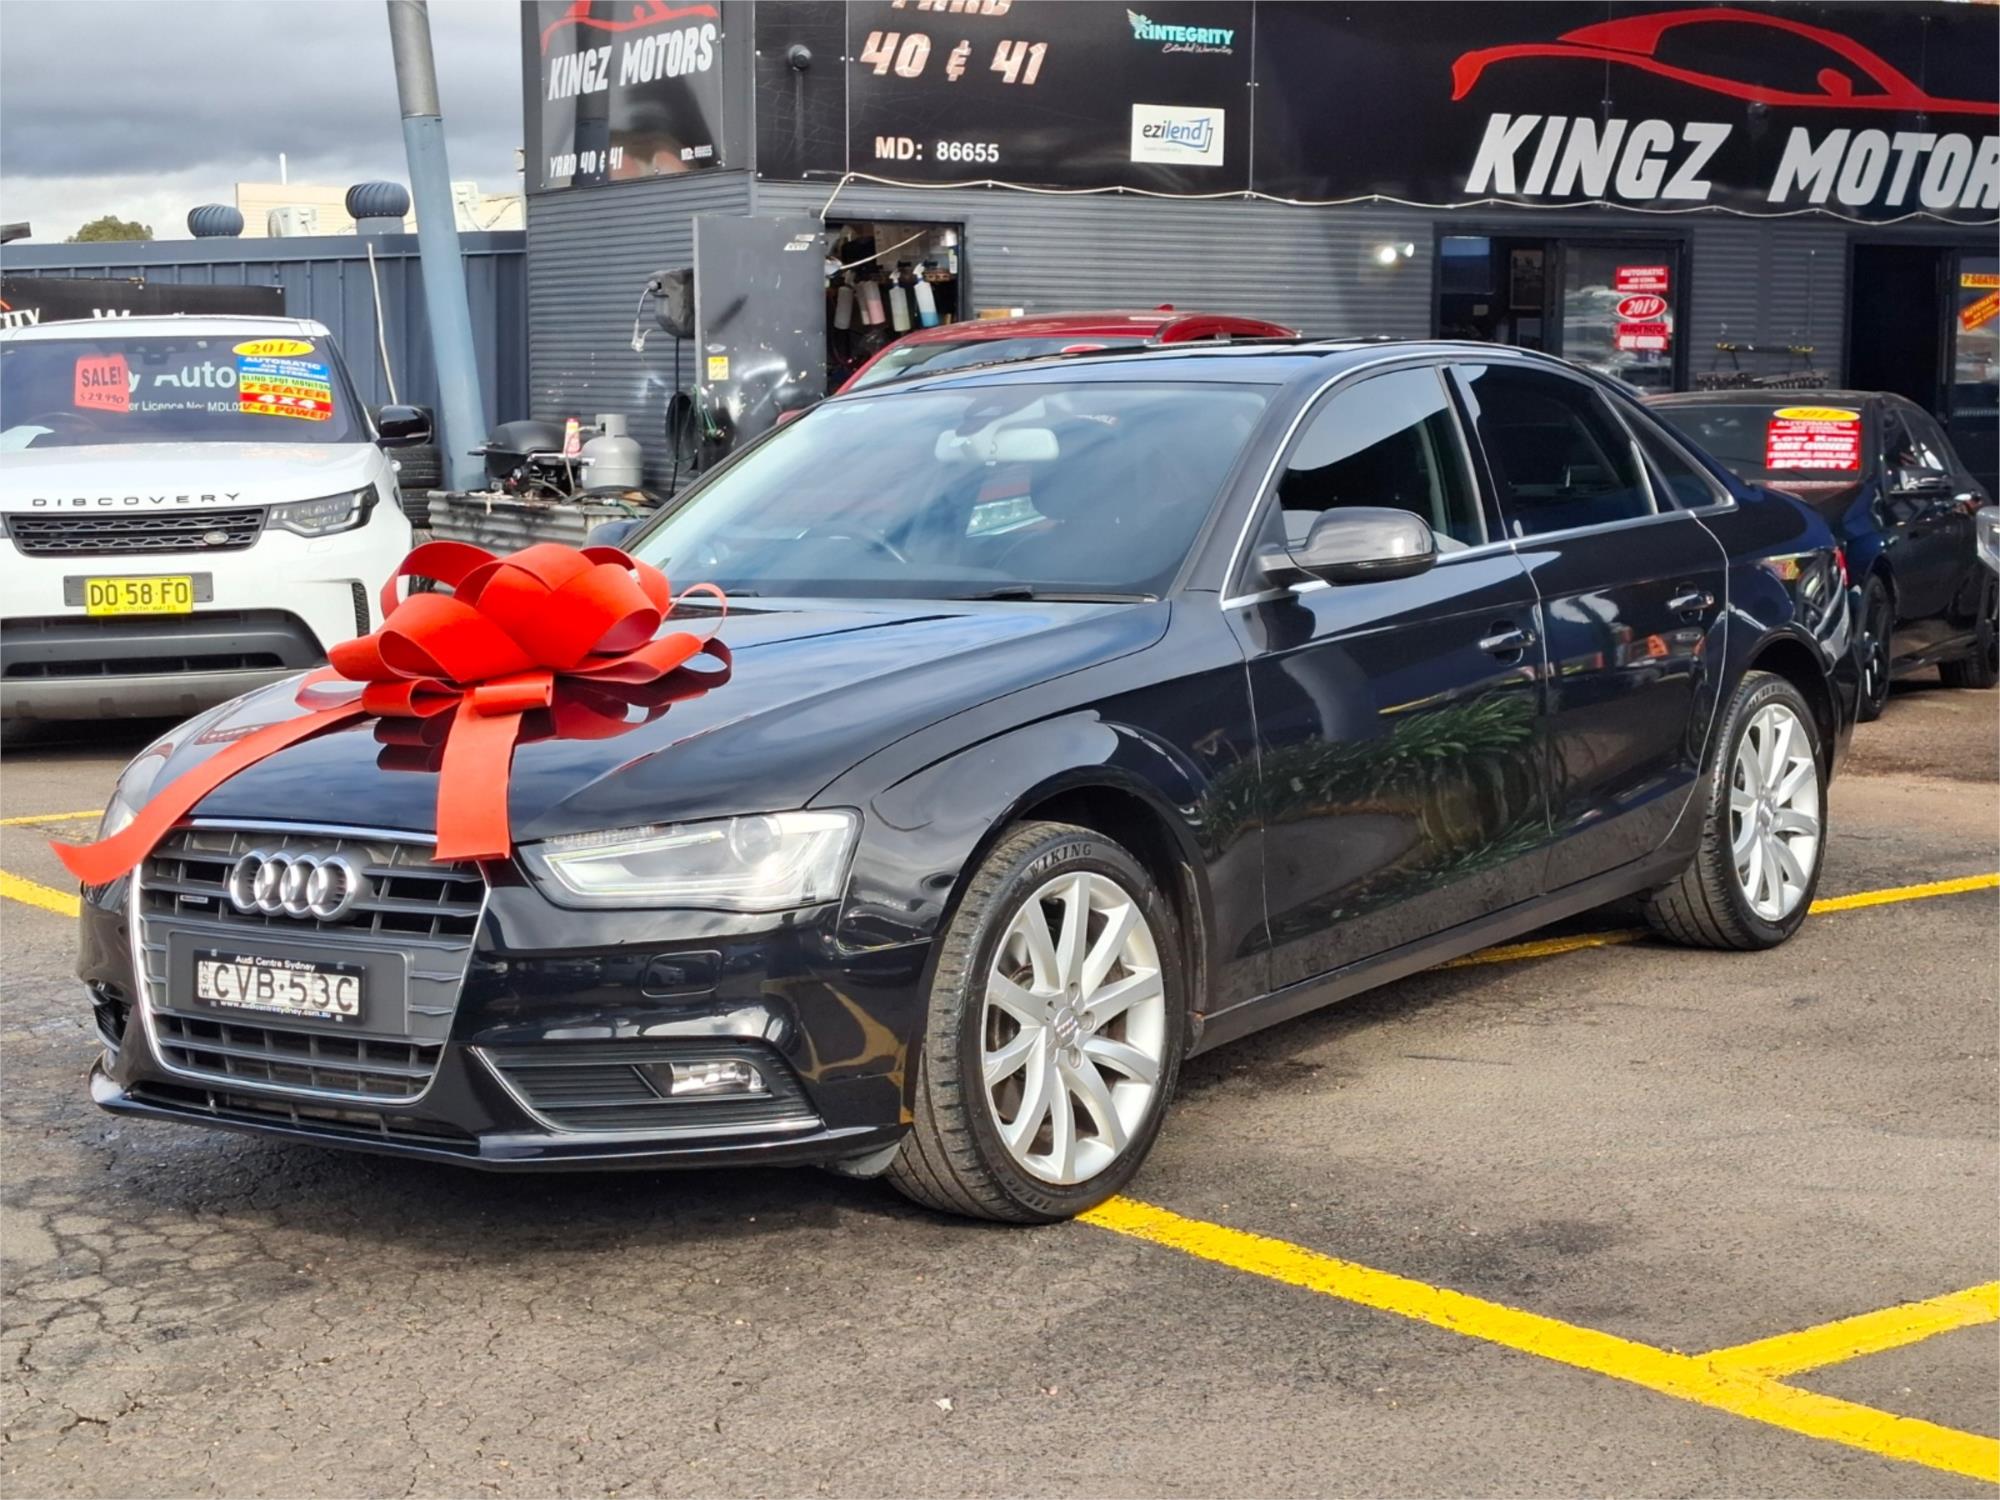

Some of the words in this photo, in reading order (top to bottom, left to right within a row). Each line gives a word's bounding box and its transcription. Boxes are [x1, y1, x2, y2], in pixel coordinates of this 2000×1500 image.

[1149, 25, 1234, 45] INTEGRITY
[548, 45, 612, 100] KINGZ
[619, 23, 716, 87] MOTORS
[860, 31, 932, 78] 40
[990, 40, 1048, 84] 41
[1142, 118, 1205, 140] ezilend
[875, 136, 923, 160] MD:
[936, 141, 1000, 163] 86655
[1464, 113, 1733, 199] KINGZ
[550, 153, 576, 178] YARD
[580, 151, 596, 174] 40
[609, 146, 624, 170] 41
[1625, 299, 1659, 315] 2019
[250, 342, 298, 355] 2017
[245, 357, 320, 369] AUTOMATIC
[82, 366, 122, 388] SALE!
[241, 374, 266, 382] BLIND
[269, 376, 289, 384] SPOT
[243, 382, 256, 391] 7
[259, 384, 327, 399] SEATER
[275, 405, 329, 419] POWER
[1773, 460, 1853, 468] SPORTY
[32, 492, 240, 506] DISCOVERY
[1028, 843, 1093, 878] VIKING
[235, 955, 254, 966] Audi
[255, 957, 283, 970] Centre
[284, 960, 316, 973] Sydney
